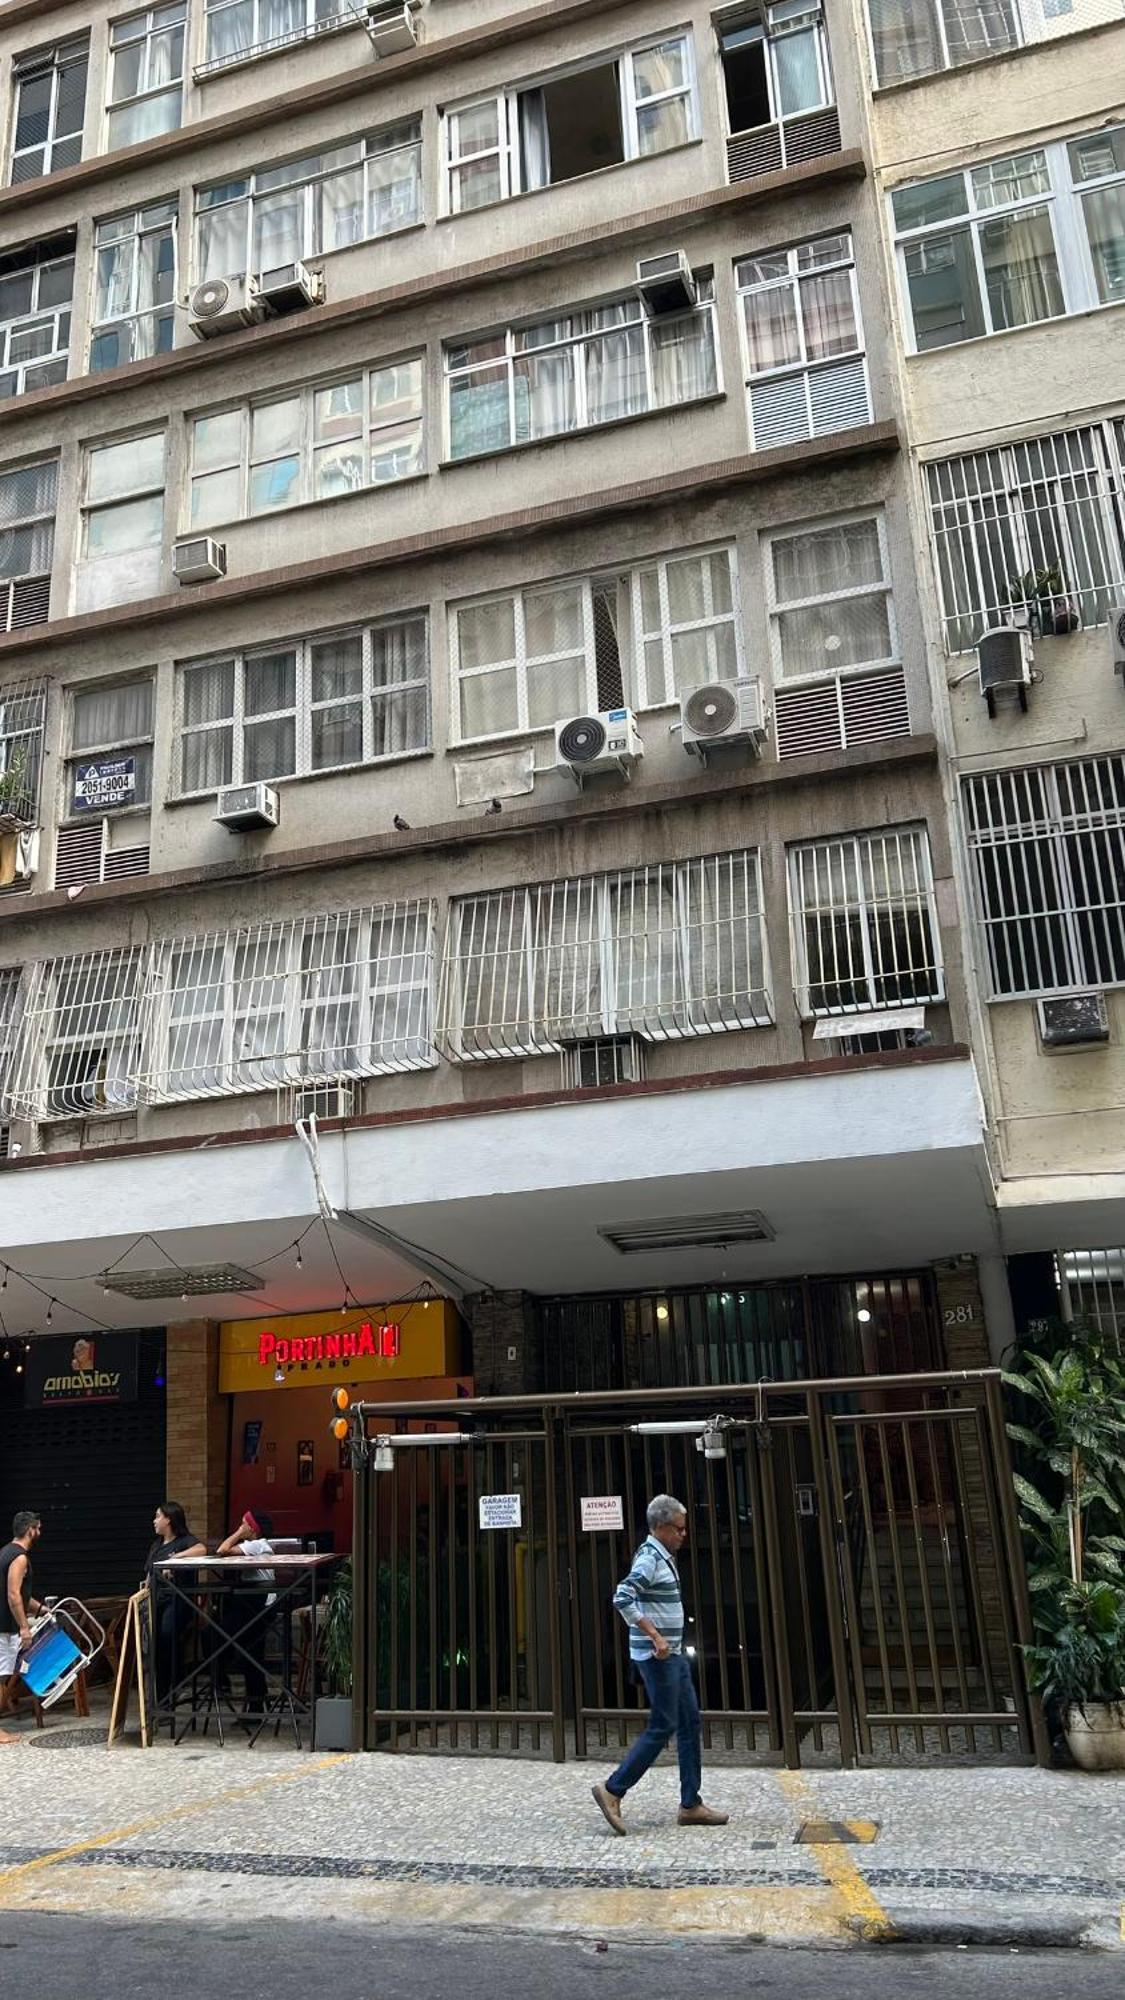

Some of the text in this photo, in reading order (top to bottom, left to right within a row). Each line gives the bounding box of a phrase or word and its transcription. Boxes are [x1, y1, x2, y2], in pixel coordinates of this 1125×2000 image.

[81, 775, 129, 795] 2051-9004
[85, 790, 125, 805] VENDE
[944, 1303, 974, 1325] 281
[258, 1322, 376, 1365] PORTINHA
[481, 1496, 518, 1505] GARAGEM
[586, 1500, 617, 1510] ATENÇÃO
